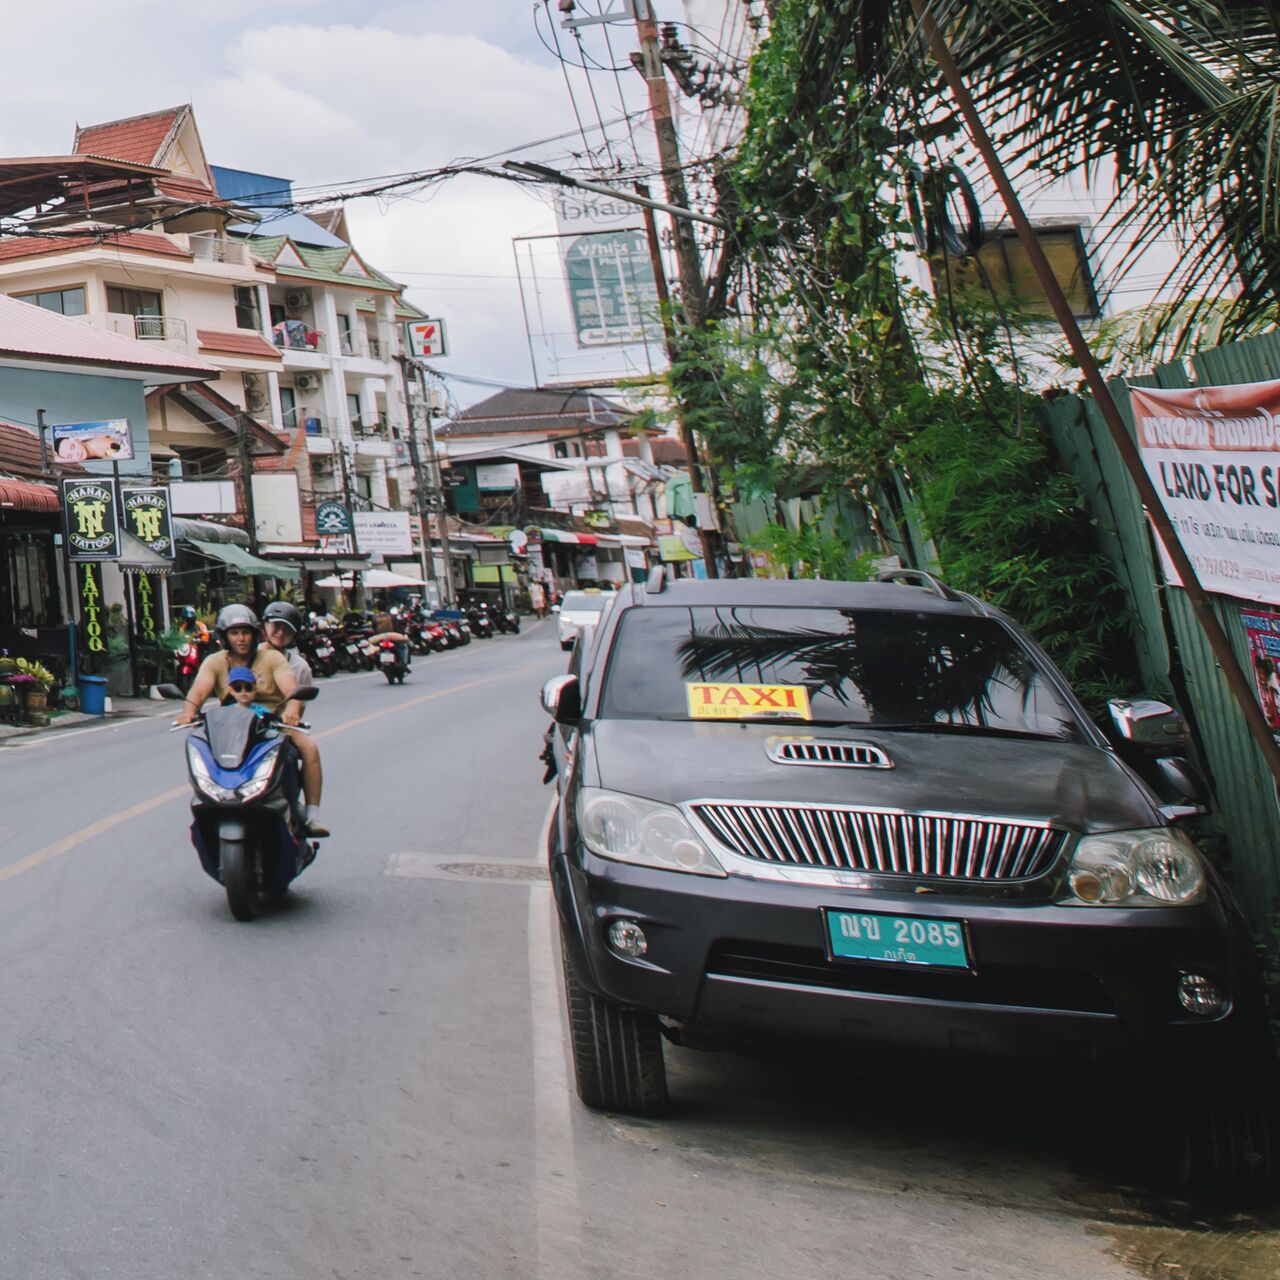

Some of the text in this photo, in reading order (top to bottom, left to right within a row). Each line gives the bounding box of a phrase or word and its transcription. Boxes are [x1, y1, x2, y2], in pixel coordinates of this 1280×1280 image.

[70, 487, 107, 500] NANAI
[1159, 461, 1280, 509] LAND FOR S
[129, 495, 162, 509] NANAI
[74, 535, 110, 549] TATTOO
[80, 563, 103, 651] TATTOO
[693, 686, 797, 707] TAXI
[893, 919, 961, 947] 2085
